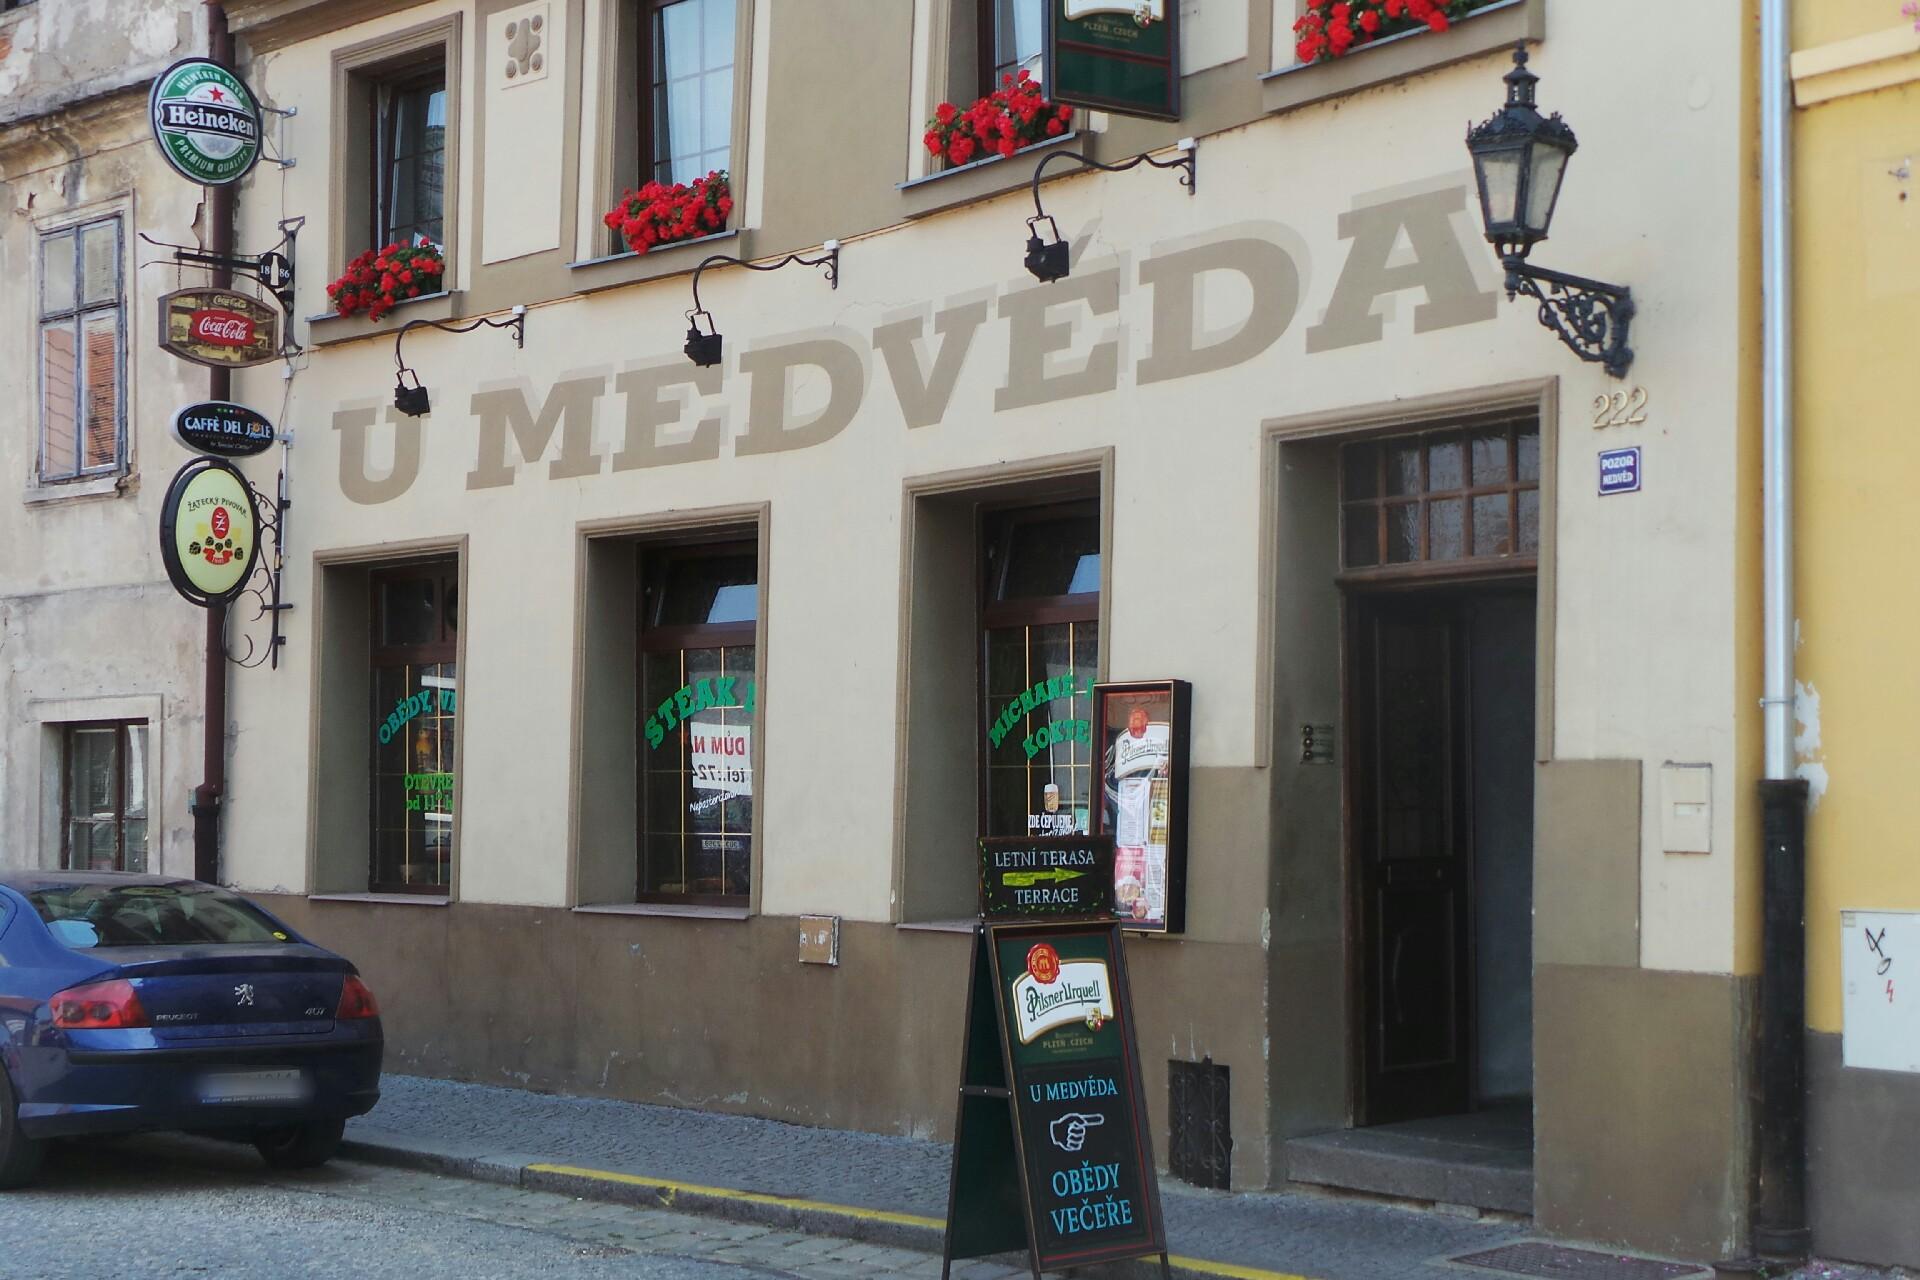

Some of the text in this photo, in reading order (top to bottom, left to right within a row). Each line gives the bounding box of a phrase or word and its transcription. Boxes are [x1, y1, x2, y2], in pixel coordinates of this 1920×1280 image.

[176, 71, 245, 99] HEINEKEN BEER
[168, 105, 254, 137] Heineken
[175, 138, 248, 173] PREMIUM QUALITY
[1592, 385, 1648, 430] 222
[223, 420, 243, 434] DEL
[332, 392, 436, 506] U
[1602, 456, 1634, 470] POZOR
[644, 676, 737, 750] STEAK
[989, 668, 1077, 749] MÍCHANÉ
[1022, 719, 1091, 760] KOKTE
[406, 794, 420, 811] od
[995, 848, 1037, 867] LETNÍ
[1041, 849, 1095, 866] TERASA
[1014, 888, 1079, 904] TERRACE
[156, 1013, 199, 1021] PEUGEOT
[1025, 979, 1101, 1022] Pilsner Urquell
[1030, 1075, 1119, 1103] U MEDVĚDA
[1052, 1160, 1120, 1198] OBĚDY
[1050, 1194, 1134, 1236] VEČEŘE
